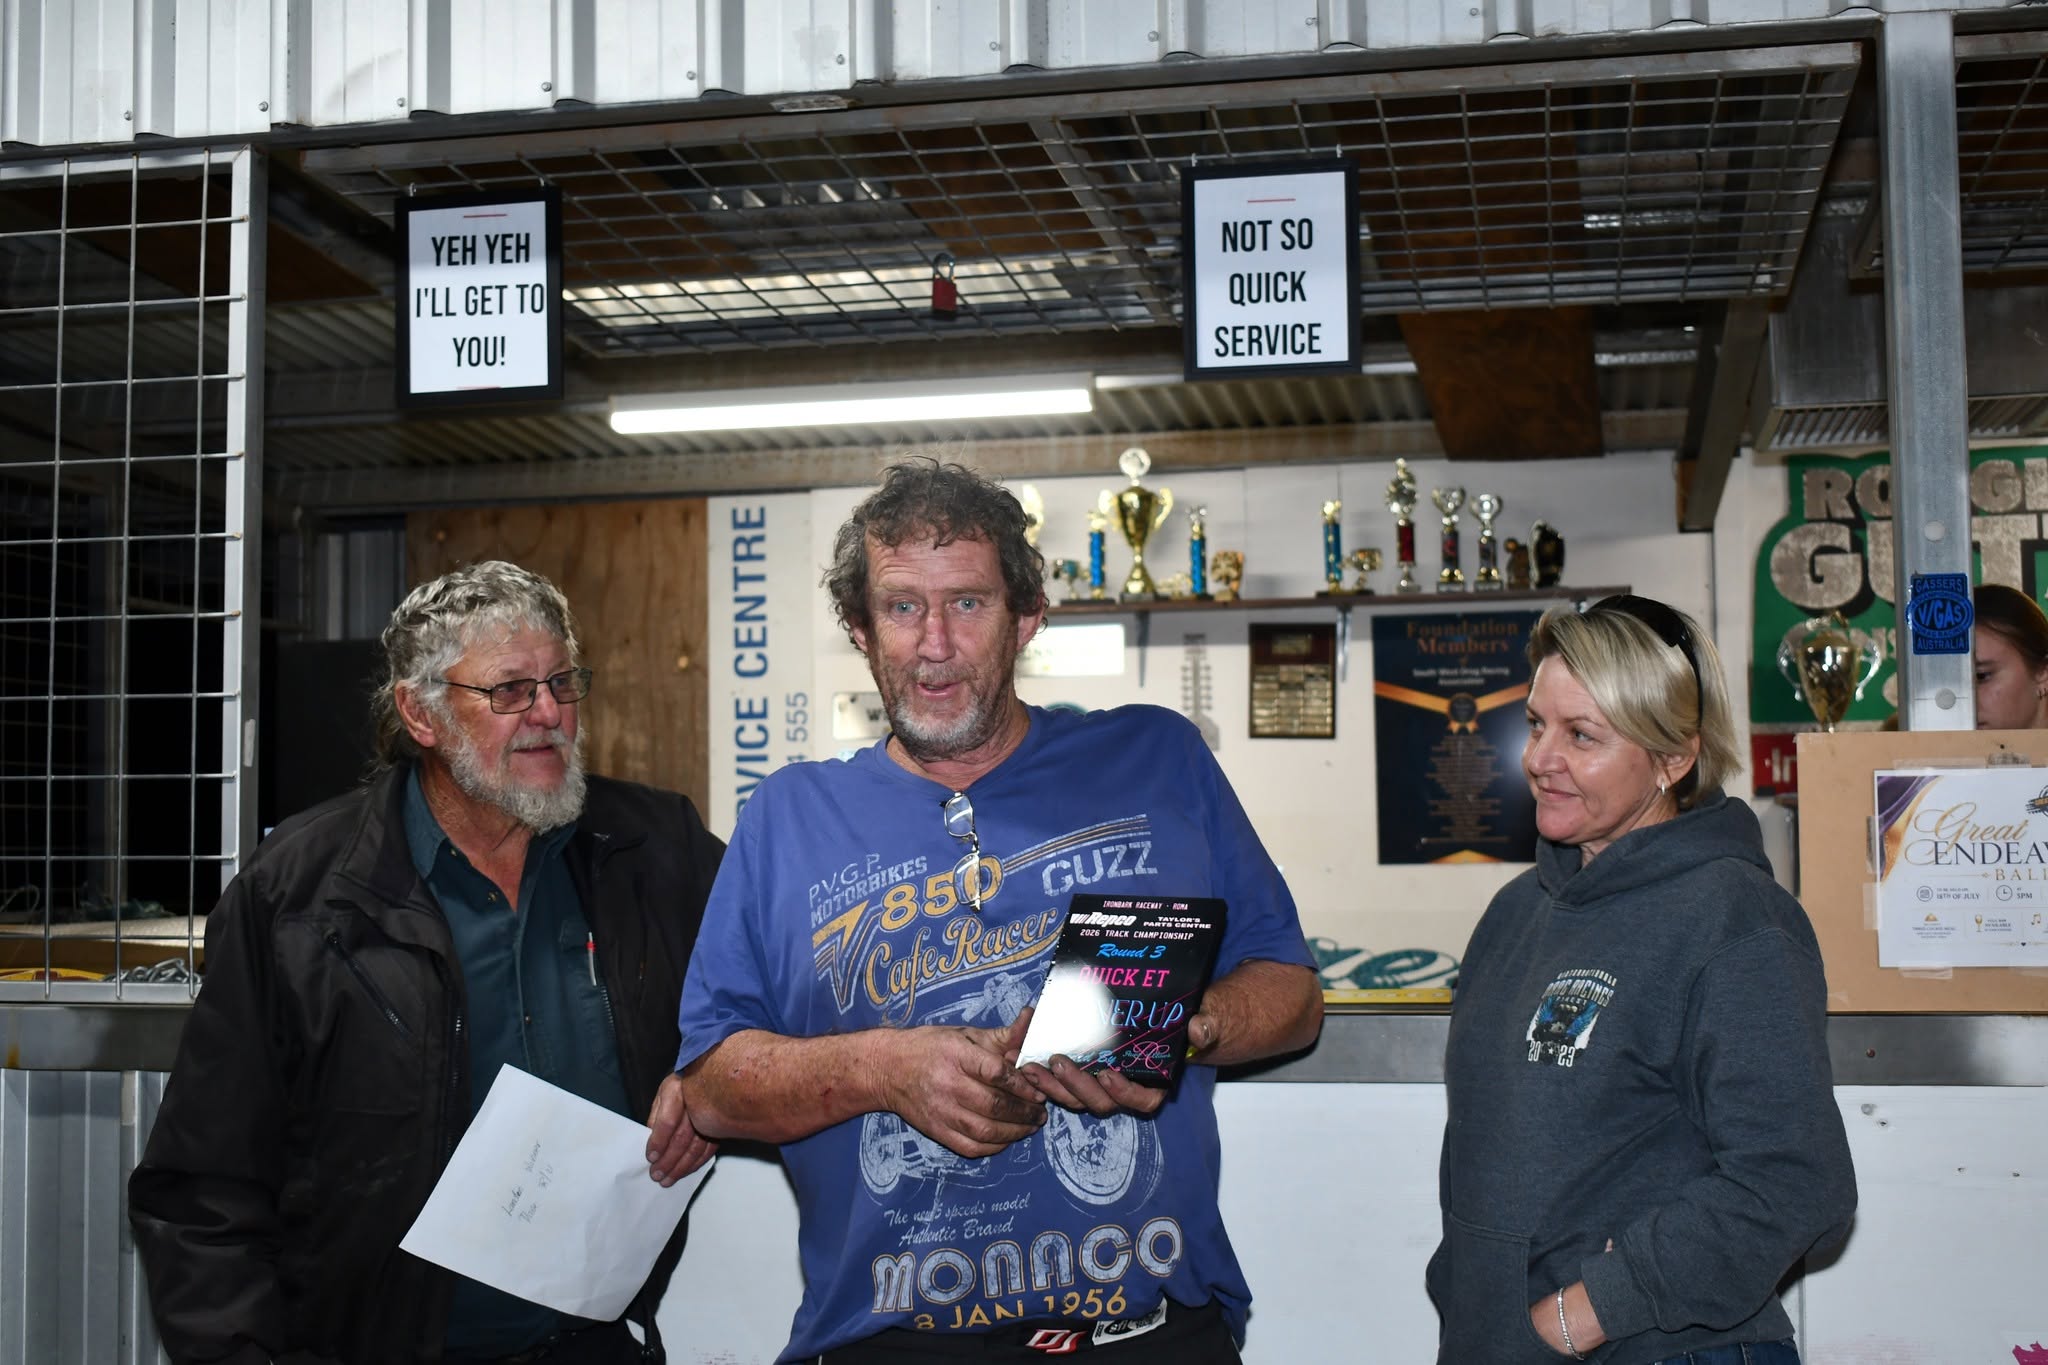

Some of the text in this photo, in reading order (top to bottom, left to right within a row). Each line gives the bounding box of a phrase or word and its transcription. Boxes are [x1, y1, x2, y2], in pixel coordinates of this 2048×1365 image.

[431, 232, 530, 267] YEH YEH
[1221, 218, 1313, 253] NOT SO
[416, 283, 544, 318] I'LL GET TO
[1229, 270, 1307, 306] QUICK
[453, 336, 506, 367] YOU!
[1214, 323, 1322, 358] SERVICE
[732, 506, 769, 679] CENTRE
[1914, 578, 1963, 593] GASSERS
[1407, 617, 1520, 638] Foundation
[1919, 600, 1962, 629] V/GAS
[1417, 638, 1509, 655] Members
[1917, 637, 1965, 649] AUSTRALIA
[1914, 802, 2029, 850] Great
[1042, 840, 1158, 898] GUZZ
[810, 855, 928, 929] MOTORBIKES
[880, 855, 1004, 931] 850
[1103, 900, 1189, 911] IRONBARK RACEWAY ROMA
[1085, 911, 1137, 928] Repco
[1105, 929, 1129, 938] TRACK
[1133, 930, 1194, 941] CHAMPIONSHIP
[864, 908, 1058, 1022] Cafe Racer
[1096, 943, 1167, 959] Round 3
[1079, 967, 1170, 988] QUICK ET
[1148, 1000, 1185, 1029] UP
[1528, 1040, 1575, 1067] 20 23
[884, 1208, 908, 1227] The
[991, 1192, 1031, 1212] model
[898, 1216, 1014, 1247] Authentic Brand
[1043, 1285, 1127, 1319] 1956
